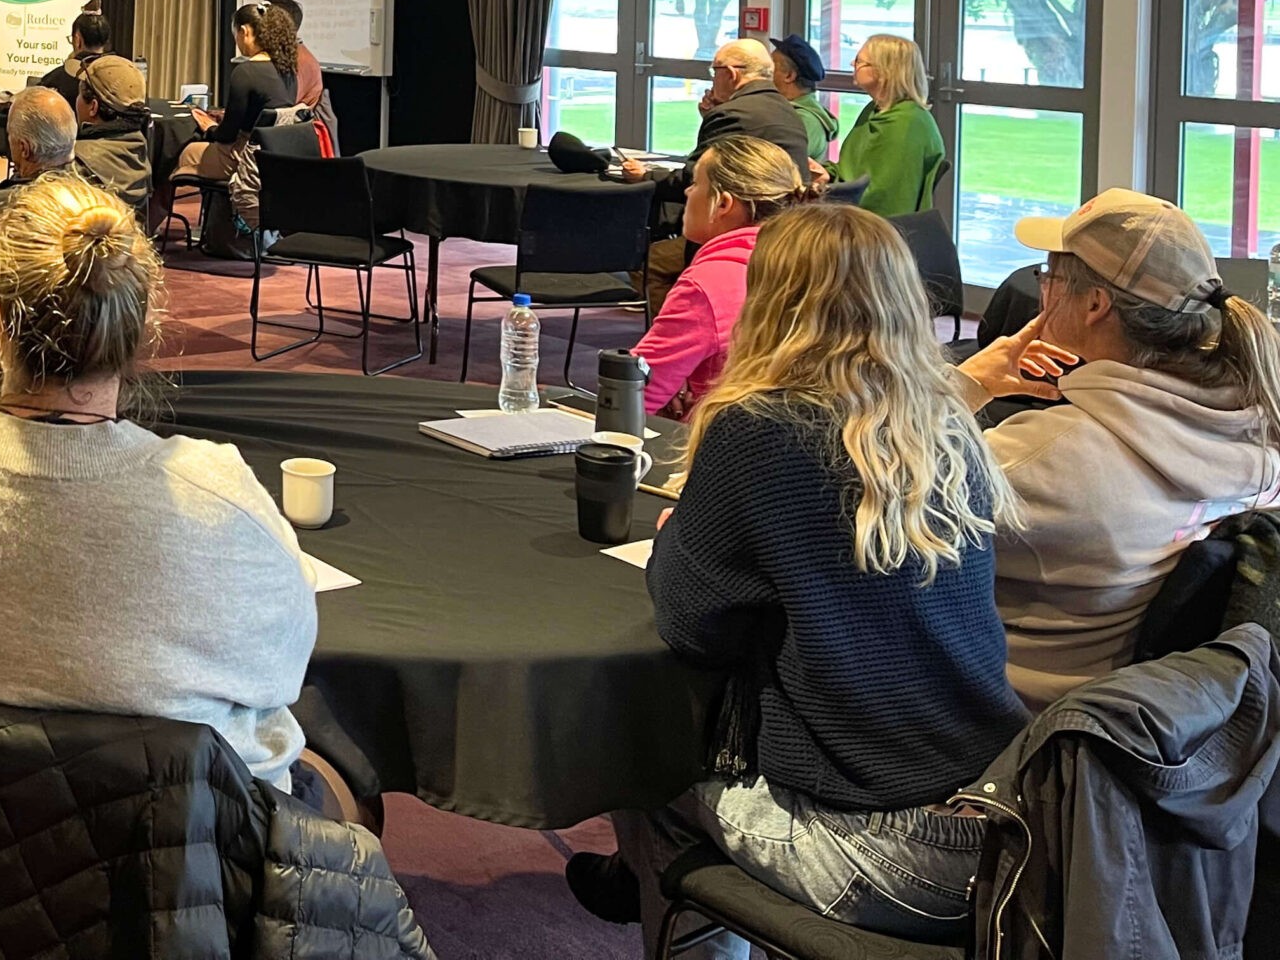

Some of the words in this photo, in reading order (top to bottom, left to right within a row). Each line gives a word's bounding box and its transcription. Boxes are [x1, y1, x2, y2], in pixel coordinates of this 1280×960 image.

[16, 39, 39, 49] Your
[41, 41, 58, 50] soil
[6, 53, 29, 63] Your
